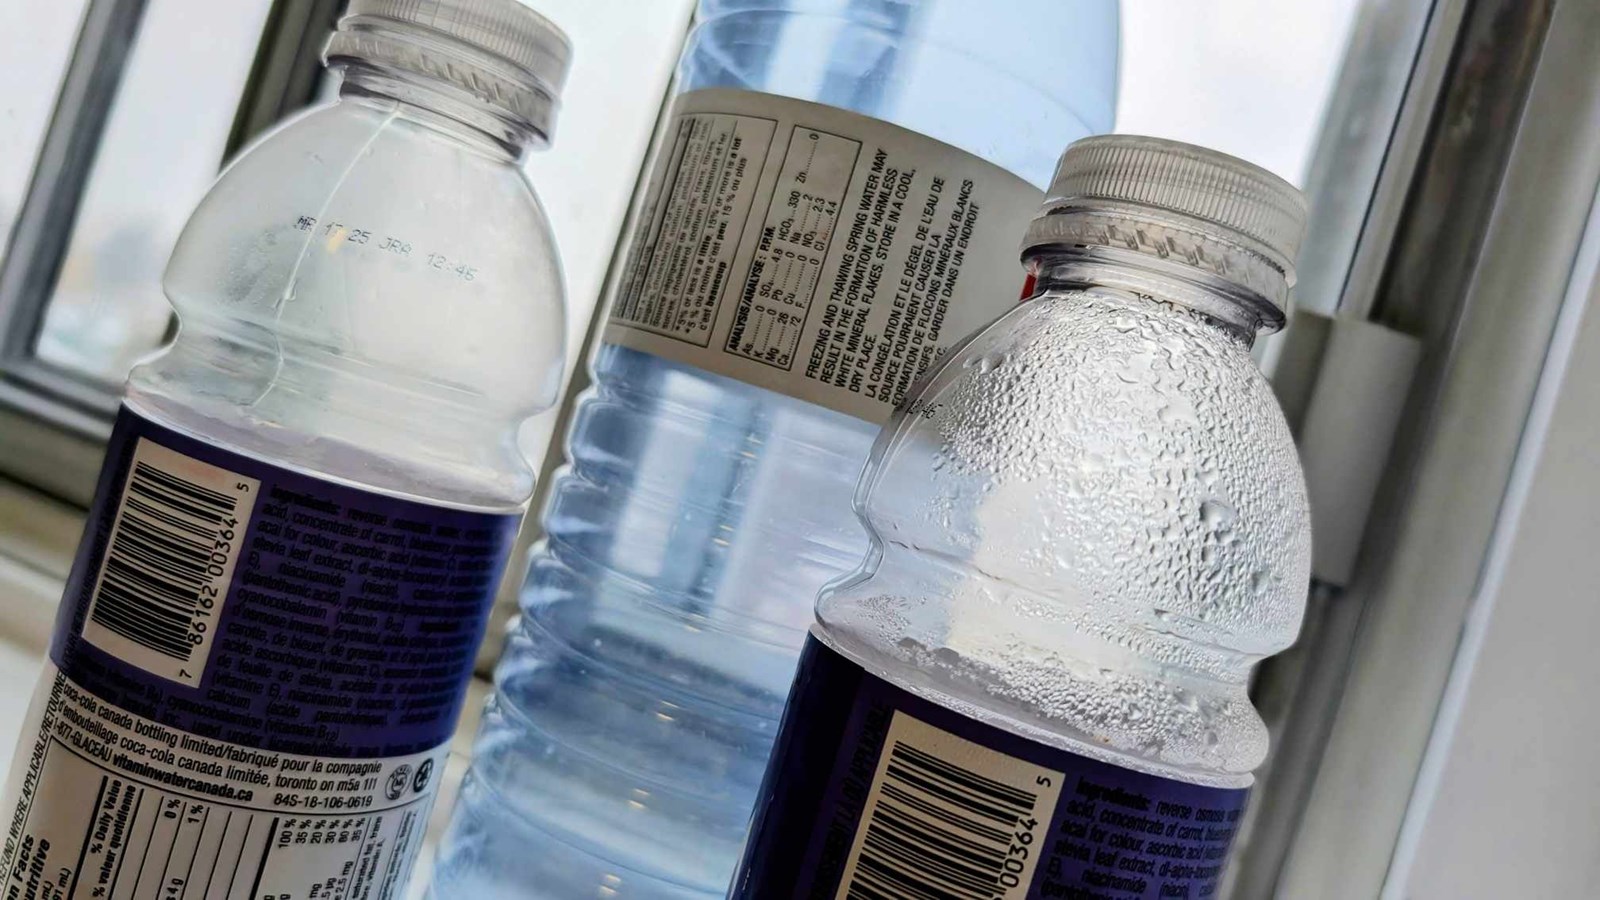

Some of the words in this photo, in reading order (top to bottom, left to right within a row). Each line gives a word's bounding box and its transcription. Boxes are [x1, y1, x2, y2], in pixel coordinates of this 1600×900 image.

[731, 137, 742, 151] lot
[726, 161, 735, 169] is
[735, 157, 747, 178] plus
[871, 148, 888, 173] MAY
[701, 158, 719, 204] potassium
[719, 171, 731, 195] more
[731, 179, 741, 191] ou
[859, 174, 880, 211] WATER
[895, 169, 916, 200] COOL,
[931, 177, 945, 193] DE
[715, 197, 723, 207] or
[721, 205, 732, 216] 15
[726, 194, 736, 203] %
[870, 168, 898, 227] HARMLESS
[892, 202, 904, 211] A
[921, 194, 939, 225] L'EAU
[951, 179, 973, 222] BLANCS
[707, 210, 720, 229] 15%
[888, 210, 900, 223] IN
[957, 202, 979, 249] ENDROIT
[348, 229, 371, 245] 25
[846, 213, 868, 253] SPRING
[865, 227, 878, 243] OF
[876, 224, 897, 260] STORE
[915, 225, 929, 241] DE
[903, 245, 924, 278] DÉGEL
[931, 222, 959, 278] MINÉRAUX
[952, 250, 965, 267] UN
[686, 277, 698, 296] less
[699, 266, 713, 294] moins
[705, 261, 727, 307] beaucoup
[829, 254, 855, 301] THAWING
[844, 244, 874, 307] FORMATION
[861, 264, 884, 305] FLAKES.
[899, 278, 912, 294] LE
[942, 268, 959, 298] DANS
[684, 297, 692, 308] or
[695, 295, 704, 308] ou
[893, 293, 906, 309] ET
[917, 279, 941, 329] FLOCONS
[699, 308, 712, 331] c'est
[822, 304, 839, 328] AND
[837, 308, 854, 329] THE
[878, 360, 901, 403] SOURCE
[892, 292, 922, 359] POURRAIENT
[914, 249, 936, 292] CAUSER
[928, 235, 942, 249] LA
[928, 299, 949, 342] GARDER
[833, 330, 846, 343] IN
[846, 308, 870, 353] MINERAL
[912, 329, 925, 346] DE
[805, 328, 831, 379] FREEZING
[869, 309, 902, 382] CONGÉLATION
[820, 343, 841, 384] RESULT
[834, 354, 855, 388] WHITE
[848, 370, 864, 393] DRY
[856, 335, 877, 370] PLACE.
[864, 384, 878, 398] LA
[291, 512, 359, 538] concentrate
[359, 527, 374, 541] of
[252, 536, 287, 556] stevia
[287, 544, 312, 562] leaf
[313, 551, 354, 574] extract,
[283, 525, 302, 541] for
[301, 533, 339, 552] colour,
[341, 542, 386, 561] ascorbic
[178, 668, 193, 680] 7
[187, 585, 218, 646] 86162
[207, 517, 239, 577] 00364
[236, 482, 250, 493] 5
[276, 561, 346, 588] niacinamide
[236, 588, 327, 620] cyanocobalamin
[254, 643, 317, 670] ascorbique
[63, 684, 98, 712] coca-cola
[97, 704, 134, 730] canada
[134, 719, 178, 749] bottling
[180, 731, 279, 778] limited/fabriqué
[280, 759, 310, 772] pour
[312, 759, 323, 772] la
[326, 758, 382, 776] compagnie
[112, 753, 254, 802] vitaminwatercanada.ca
[120, 737, 175, 766] coca-cola
[177, 756, 223, 777] canada
[227, 756, 271, 788] limitée,
[275, 773, 318, 791] toronto
[319, 780, 335, 791] on
[336, 778, 360, 792] m5a
[103, 780, 122, 810] Value
[167, 799, 181, 809] %
[11, 793, 32, 838] WHERE
[110, 785, 137, 849] quotidienne
[164, 811, 177, 819] 0
[190, 805, 204, 815] %
[283, 819, 297, 828] %
[342, 819, 353, 829] %
[1099, 808, 1165, 835] concentrate
[1165, 822, 1179, 838] of
[1155, 801, 1193, 820] reverse
[94, 812, 114, 841] Daily
[295, 831, 308, 844] 35
[299, 819, 312, 830] %
[310, 832, 323, 844] 20
[314, 819, 327, 830] %
[324, 831, 337, 844] 30
[328, 819, 340, 830] %
[1001, 817, 1039, 889] 00364
[1036, 775, 1051, 788] 5
[90, 843, 103, 854] %
[278, 830, 293, 849] 100
[342, 861, 354, 876] mg
[351, 827, 362, 842] 35
[1088, 825, 1107, 843] for
[1107, 832, 1145, 855] colour,
[12, 834, 34, 882] Facts
[98, 849, 116, 884] valeur
[1053, 839, 1091, 861] stevia
[1093, 847, 1119, 868] leaf
[1117, 853, 1156, 877] extract,
[92, 887, 106, 897] %
[1079, 864, 1147, 894] niacinamide
